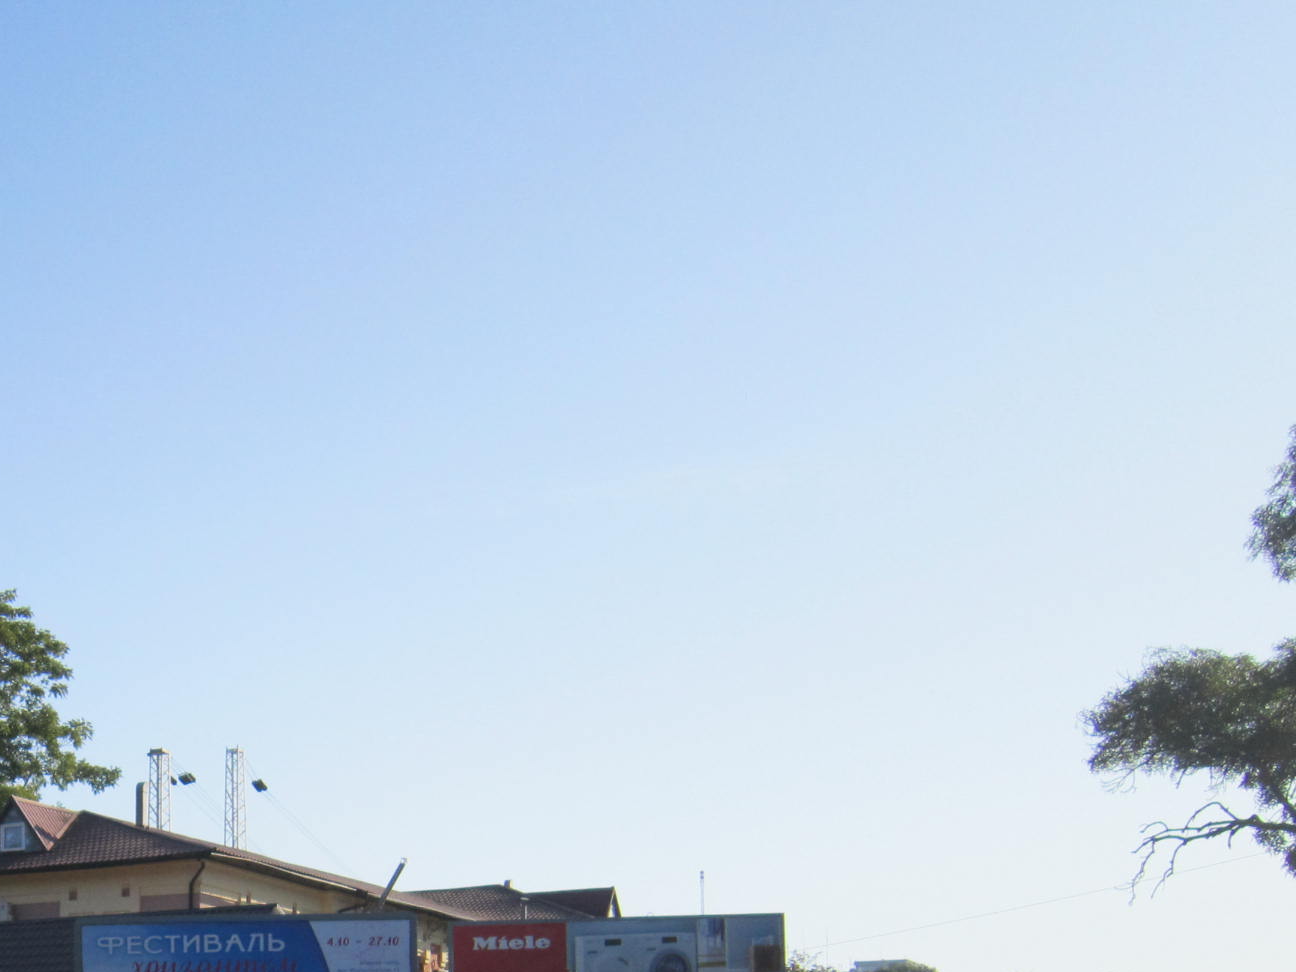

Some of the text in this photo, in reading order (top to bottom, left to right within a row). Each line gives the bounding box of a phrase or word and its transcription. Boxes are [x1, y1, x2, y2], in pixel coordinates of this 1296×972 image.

[97, 934, 286, 955] ФЕСТИВАЛЬ
[327, 937, 350, 946] 4.10
[368, 936, 400, 947] 27.10
[472, 935, 551, 951] Miele
